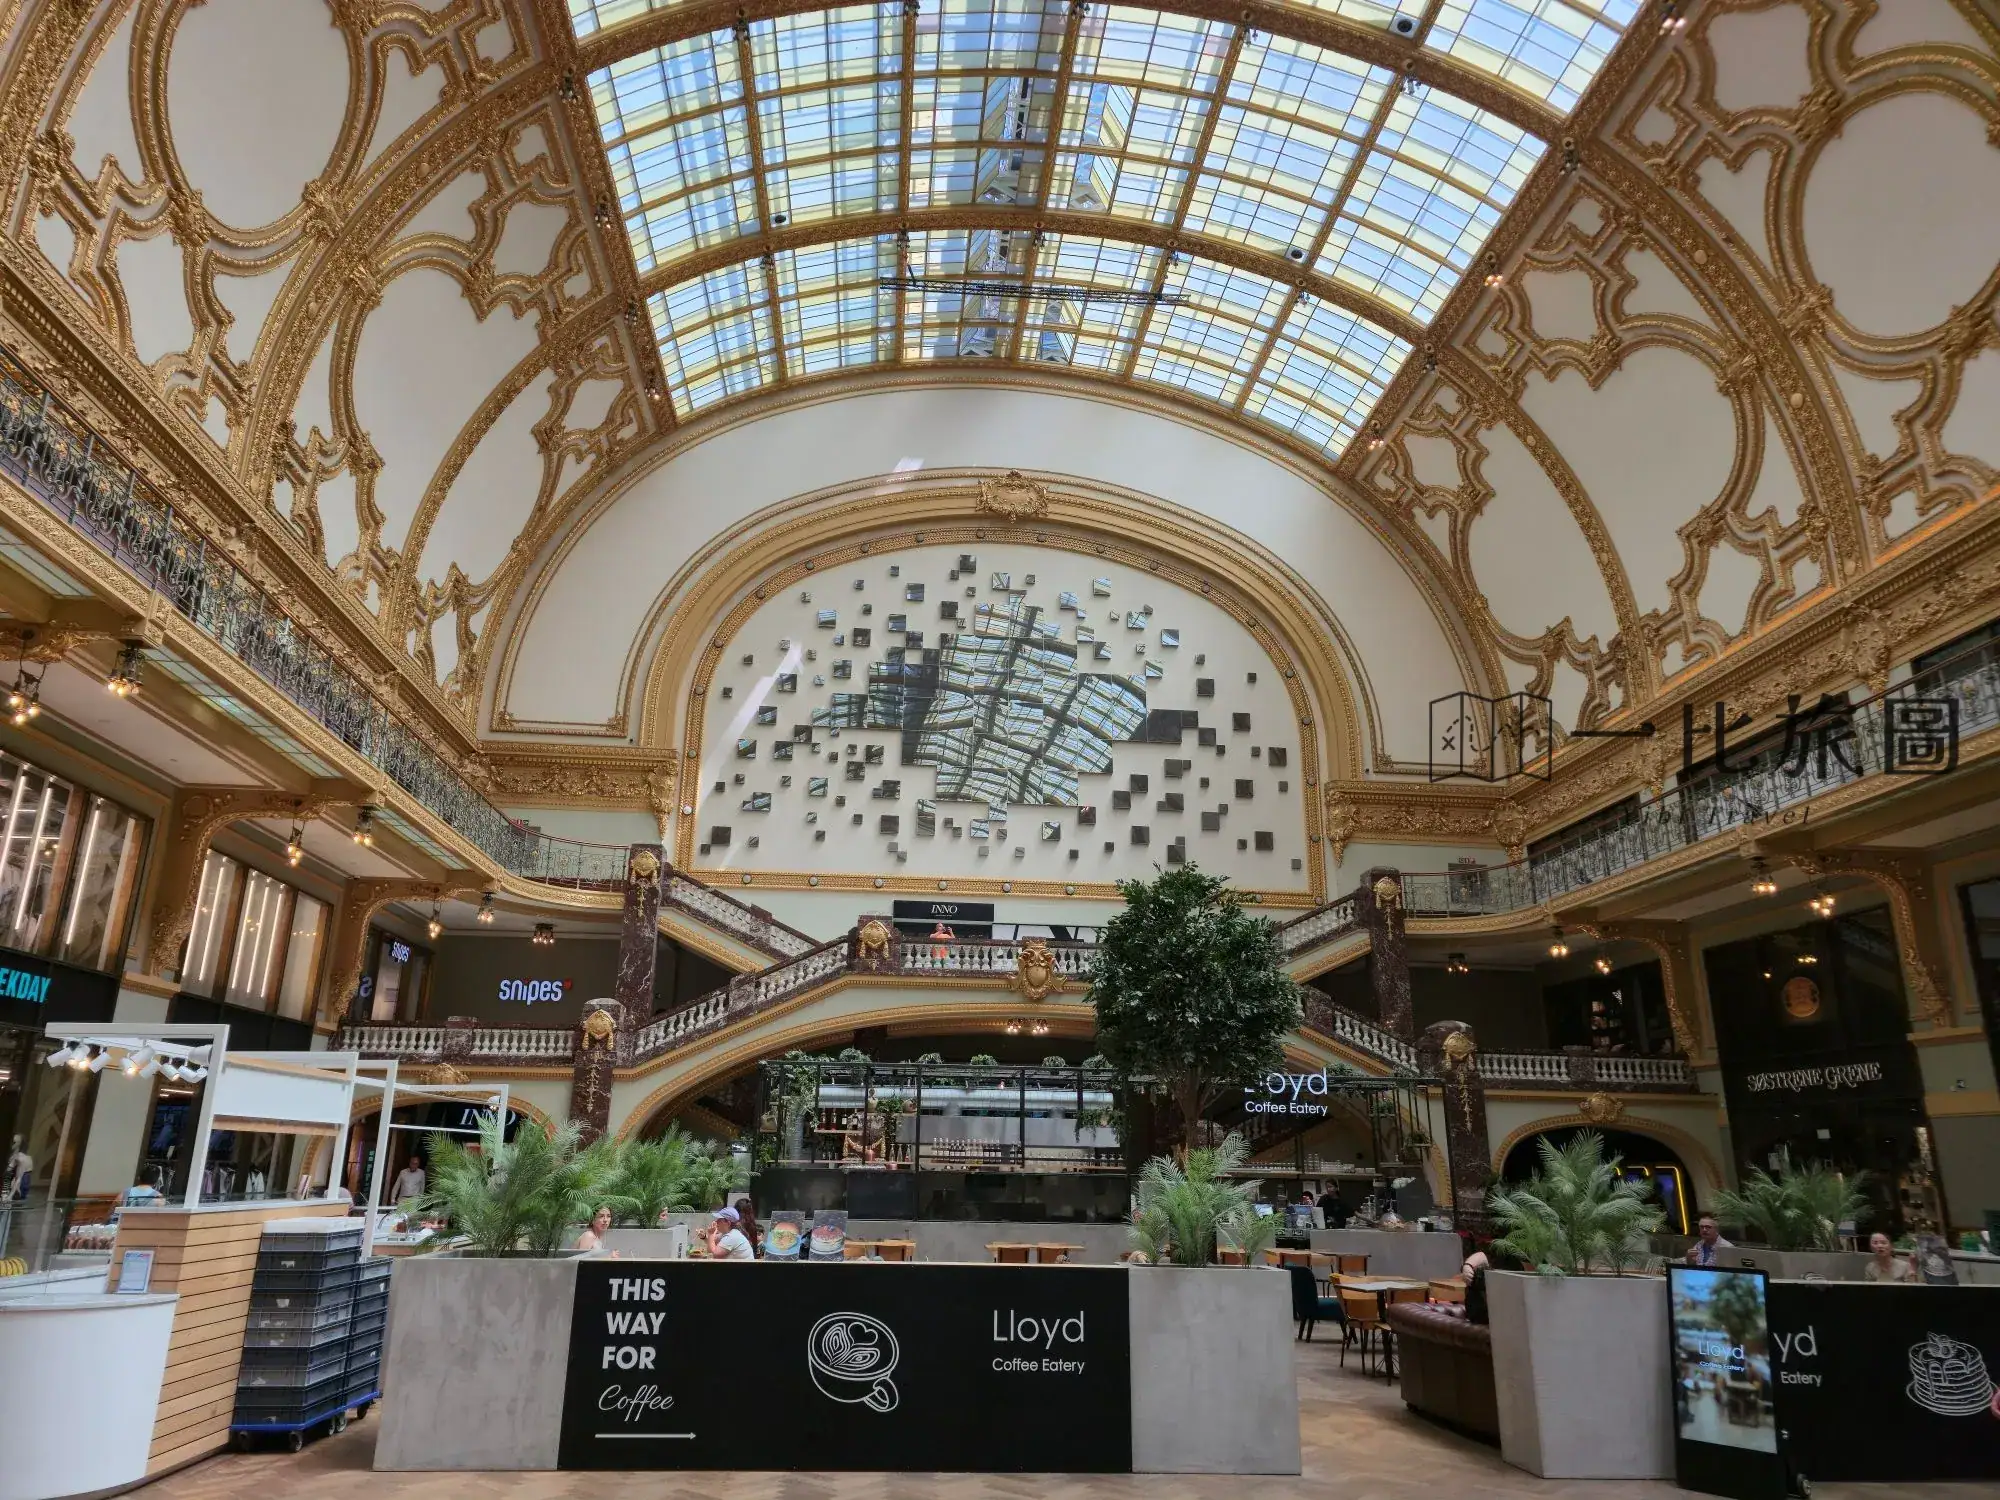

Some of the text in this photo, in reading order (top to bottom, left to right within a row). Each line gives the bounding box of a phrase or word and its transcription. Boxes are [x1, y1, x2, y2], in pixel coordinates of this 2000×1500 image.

[932, 904, 958, 914] INNO
[498, 979, 563, 1006] snipes
[1747, 1062, 1883, 1093] SØSTRENE GRENE
[1245, 1101, 1328, 1117] Coffee Eatery
[609, 1278, 666, 1301] THIS
[606, 1311, 666, 1335] WAY
[993, 1309, 1085, 1350] Lloyd
[602, 1346, 656, 1369] FOR
[1698, 1340, 1745, 1361] Lloyd
[992, 1357, 1085, 1375] Coffee Eatery
[1780, 1371, 1822, 1388] Eatery
[598, 1384, 675, 1422] Coffee
